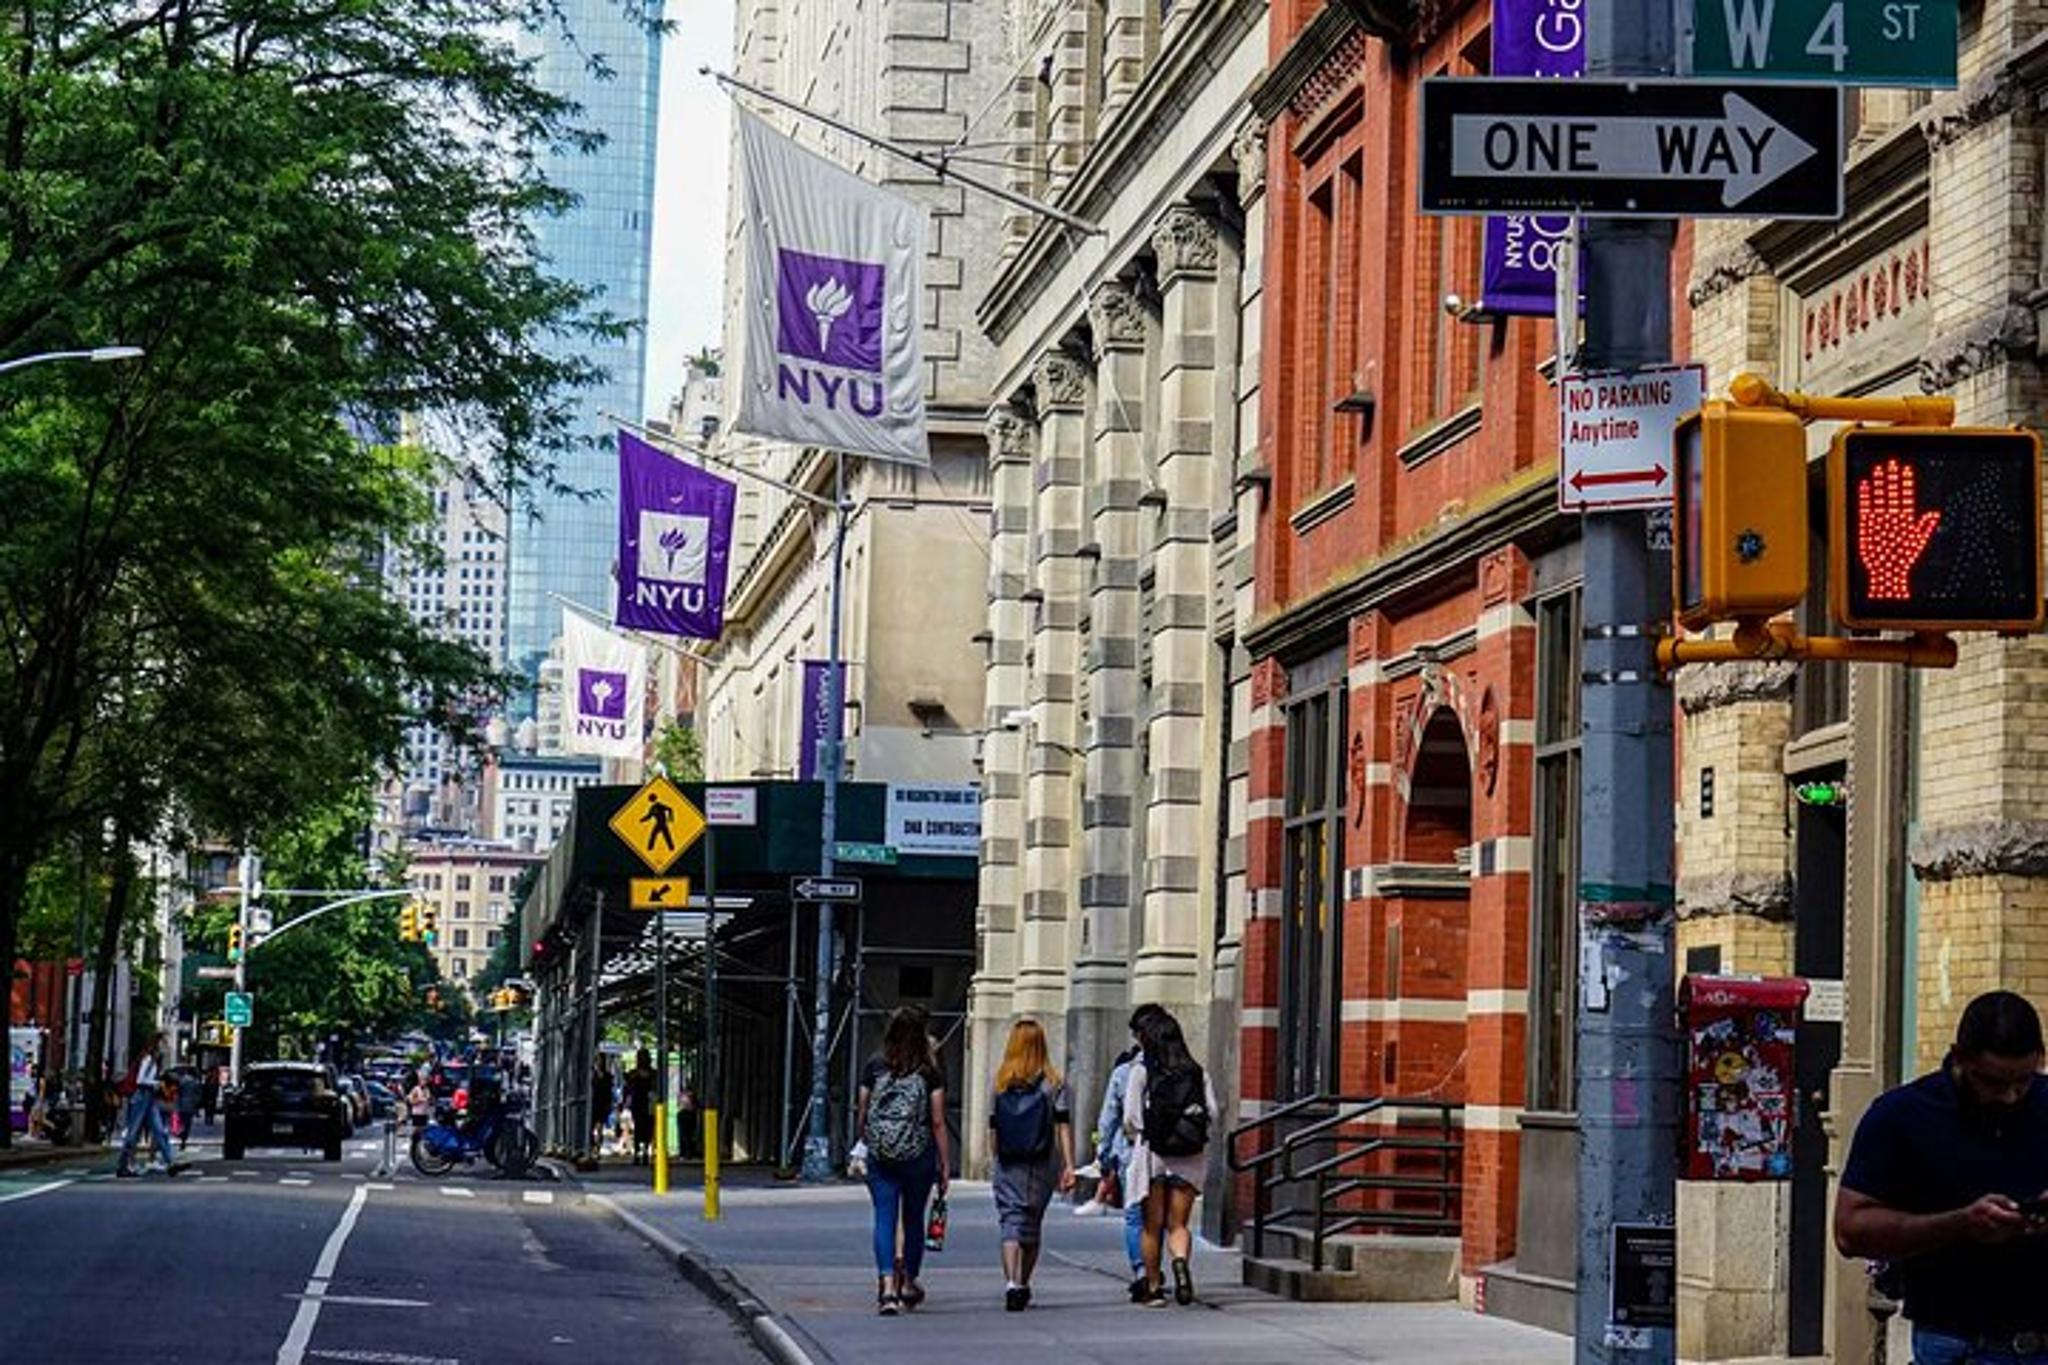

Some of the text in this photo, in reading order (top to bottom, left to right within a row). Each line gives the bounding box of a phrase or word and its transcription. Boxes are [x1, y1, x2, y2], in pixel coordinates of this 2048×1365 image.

[1723, 0, 1921, 72] W 4 ST
[1484, 122, 1776, 174] ONE WAY
[779, 363, 883, 418] NYU
[1569, 379, 1672, 412] NO PARKING
[1569, 417, 1640, 446] Anytime
[636, 581, 705, 614] NYU
[577, 718, 627, 740] NYU
